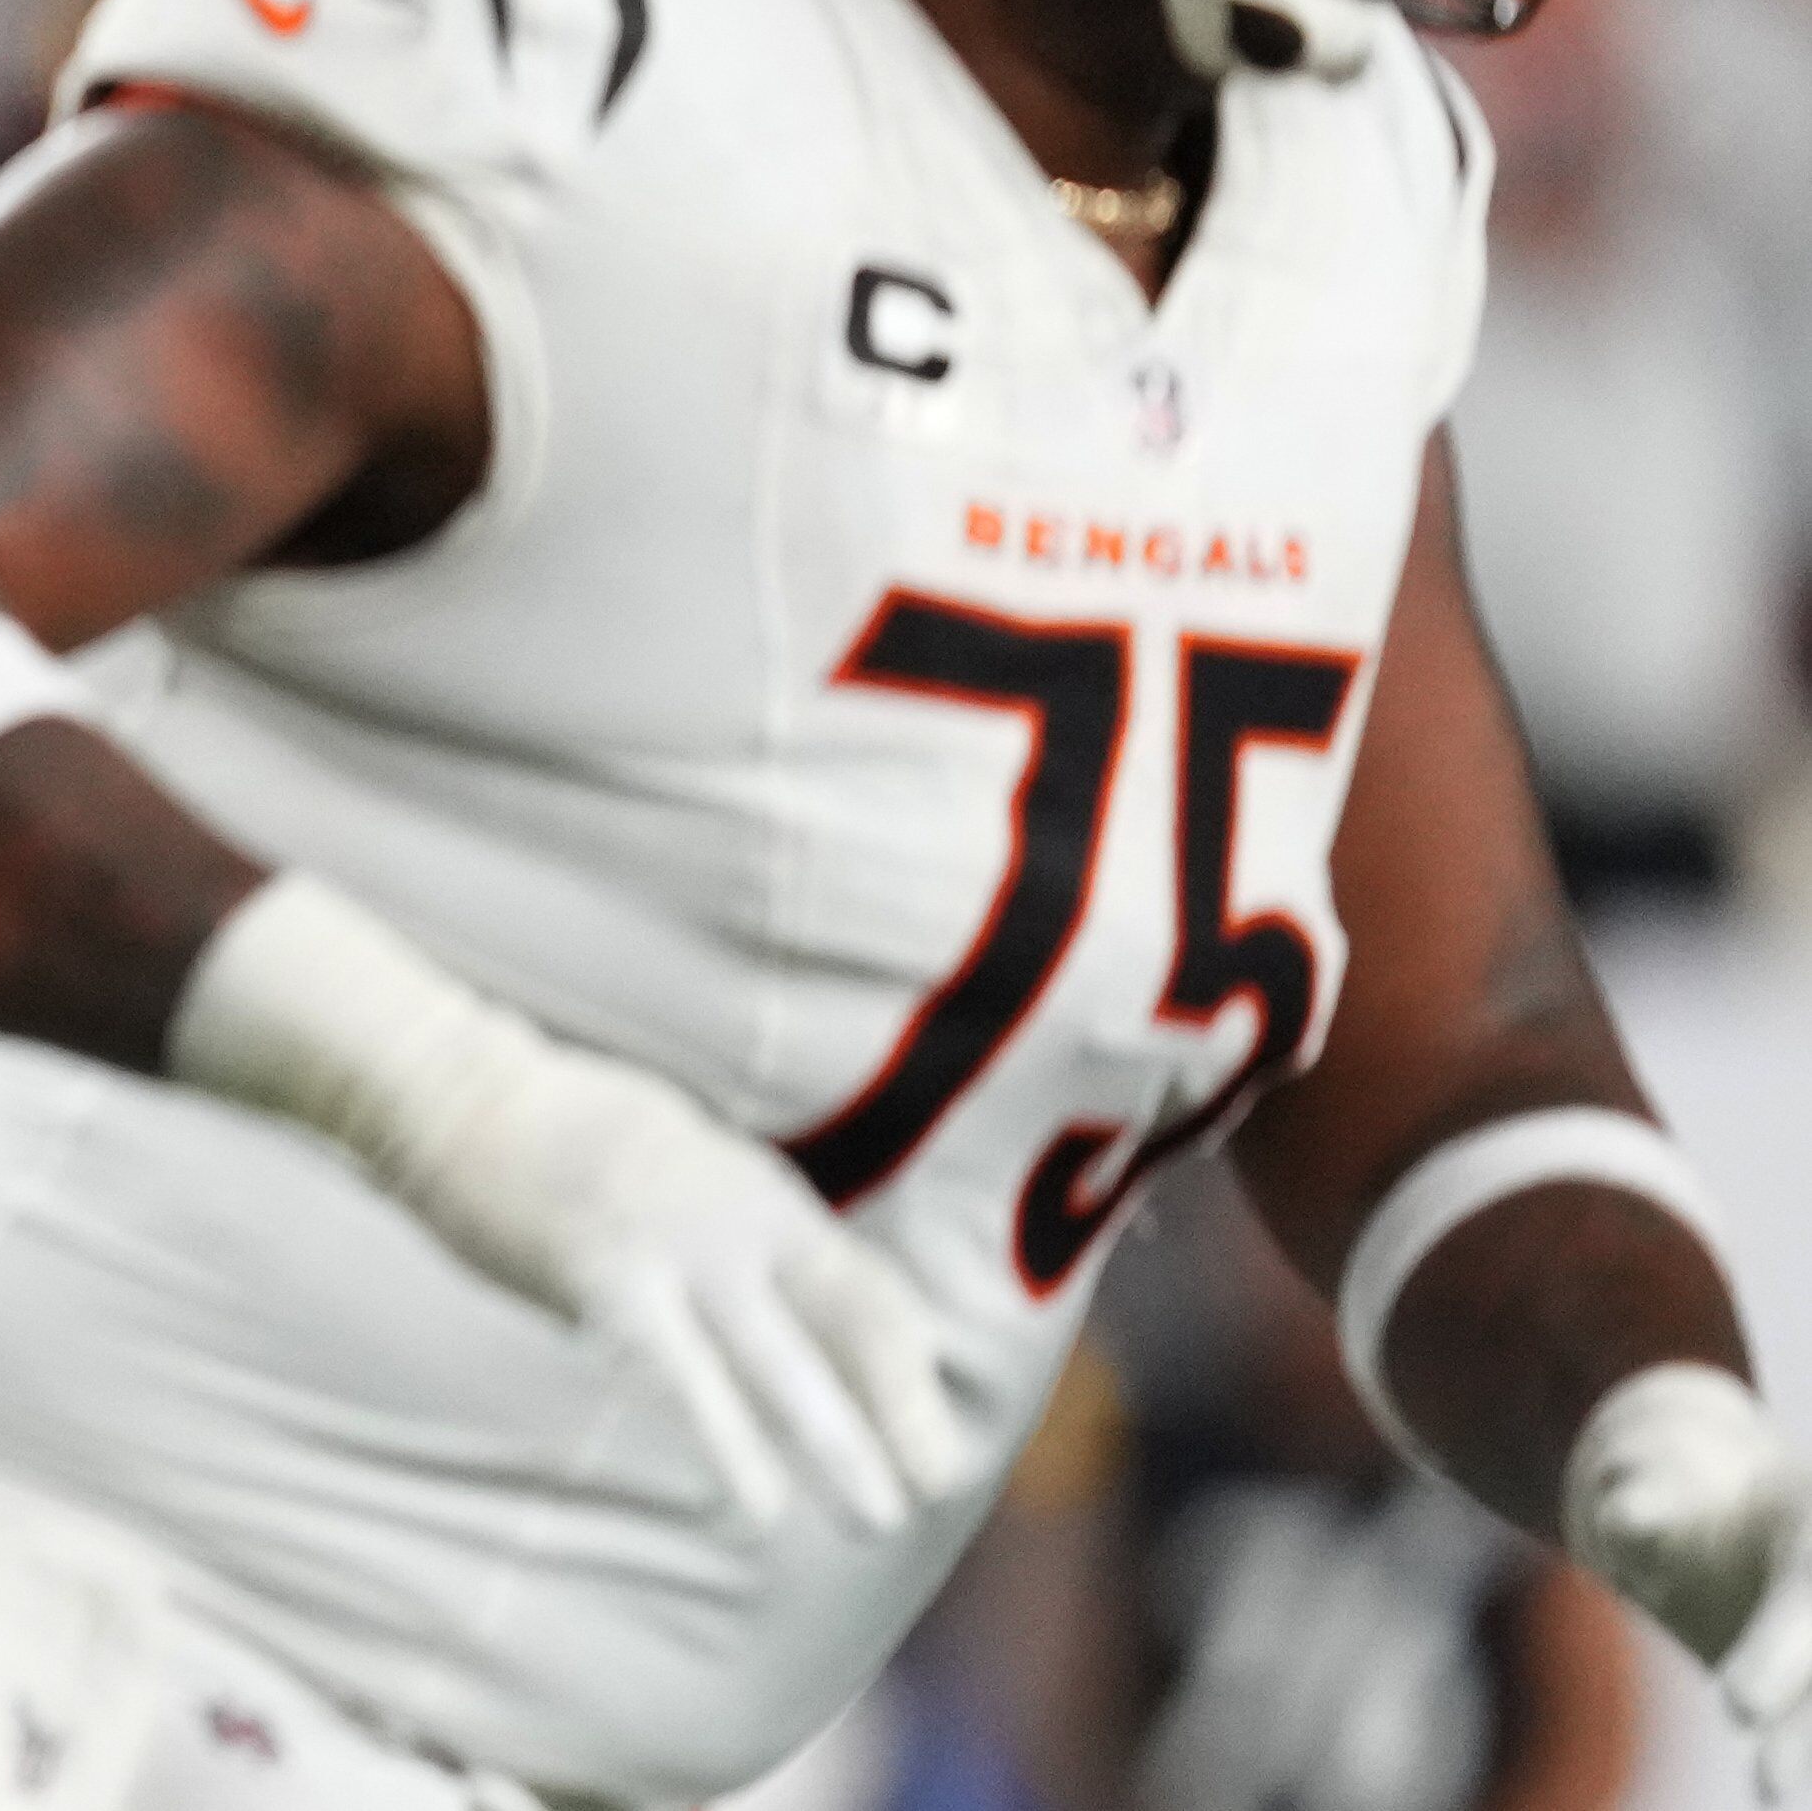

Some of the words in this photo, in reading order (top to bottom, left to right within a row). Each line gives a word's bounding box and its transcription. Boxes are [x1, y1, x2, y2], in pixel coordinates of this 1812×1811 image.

[844, 266, 955, 382] C
[965, 501, 1307, 582] BENGALS
[777, 583, 1366, 1303] 75
